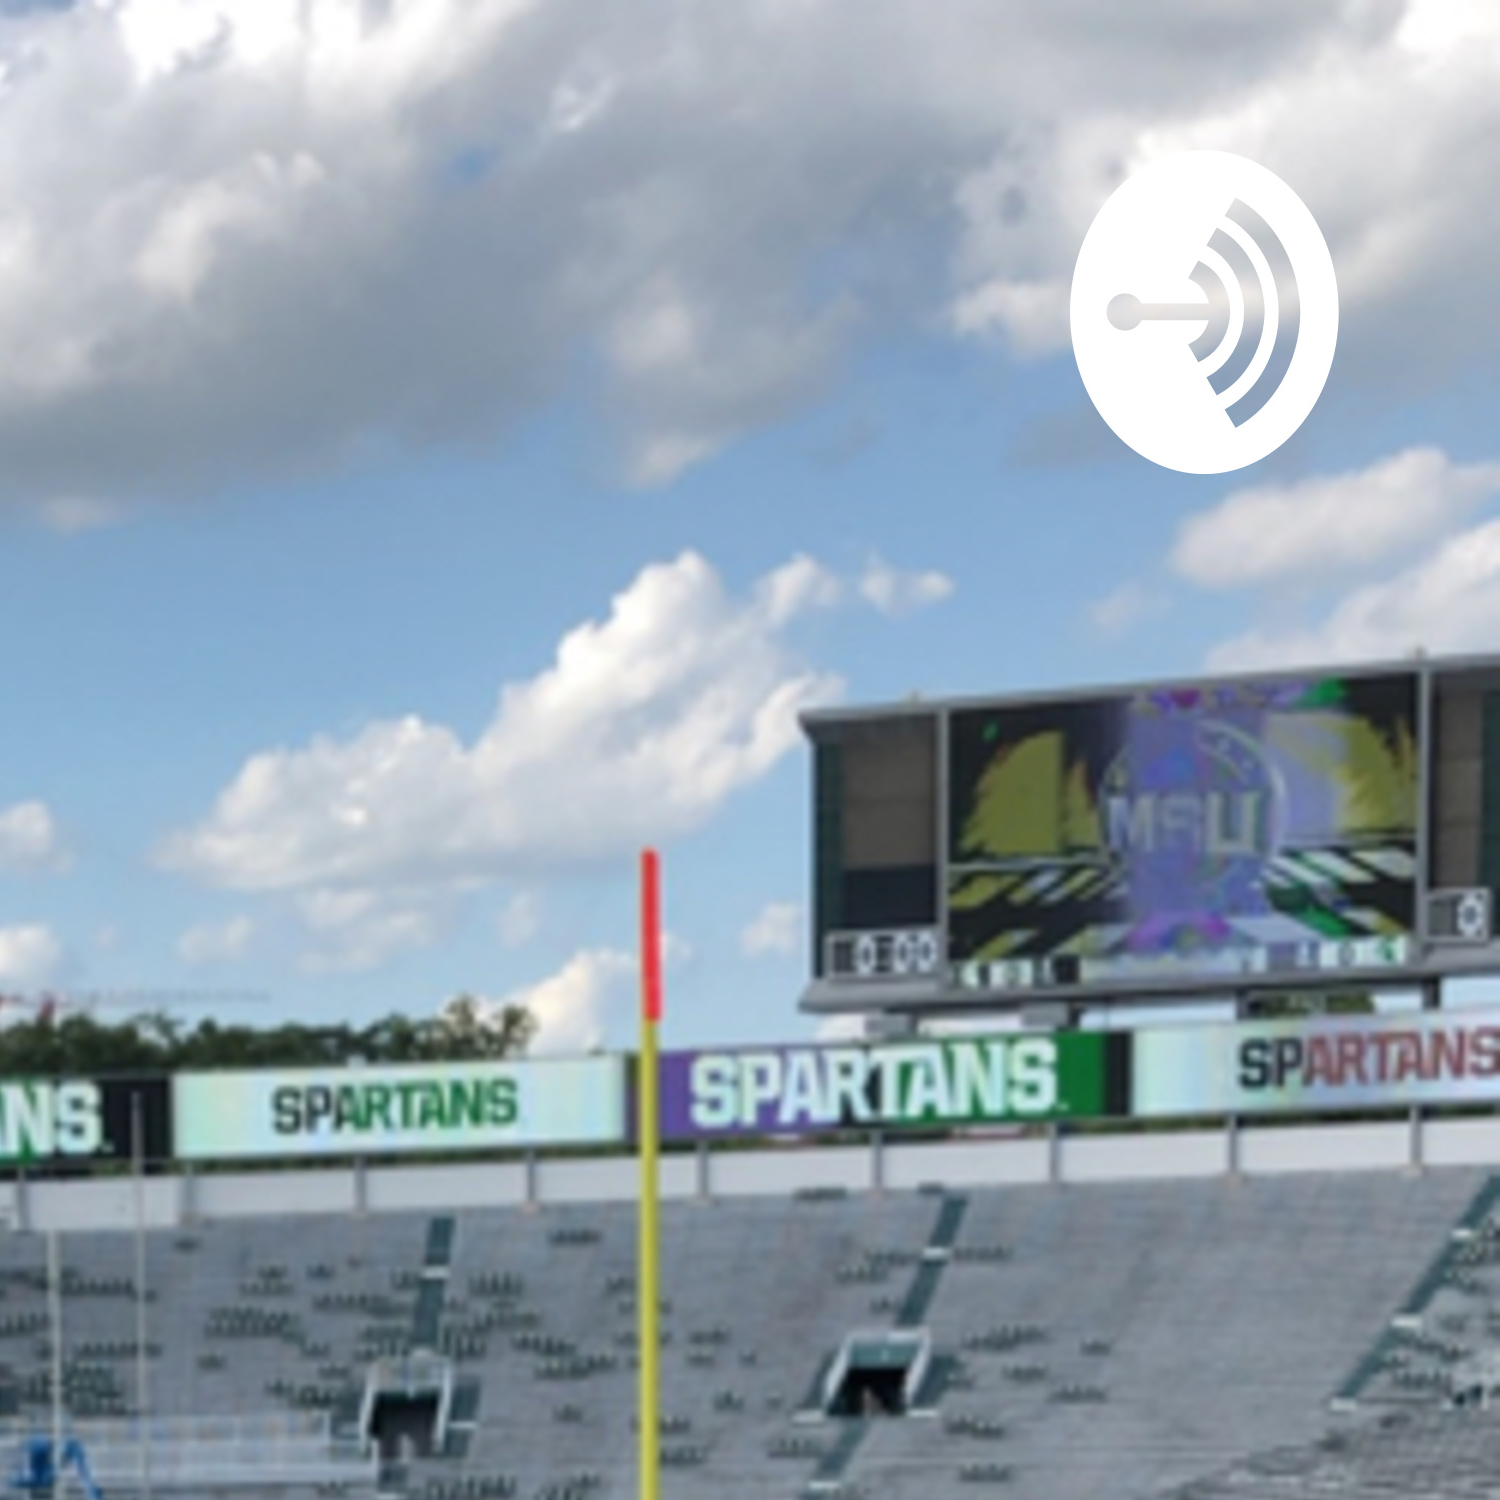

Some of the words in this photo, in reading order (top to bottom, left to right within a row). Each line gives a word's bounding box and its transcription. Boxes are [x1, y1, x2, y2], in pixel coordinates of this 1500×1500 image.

[689, 1038, 1058, 1129] SPARTANS
[1238, 1026, 1500, 1090] SPARTANS
[272, 1078, 518, 1135] SPARTANS
